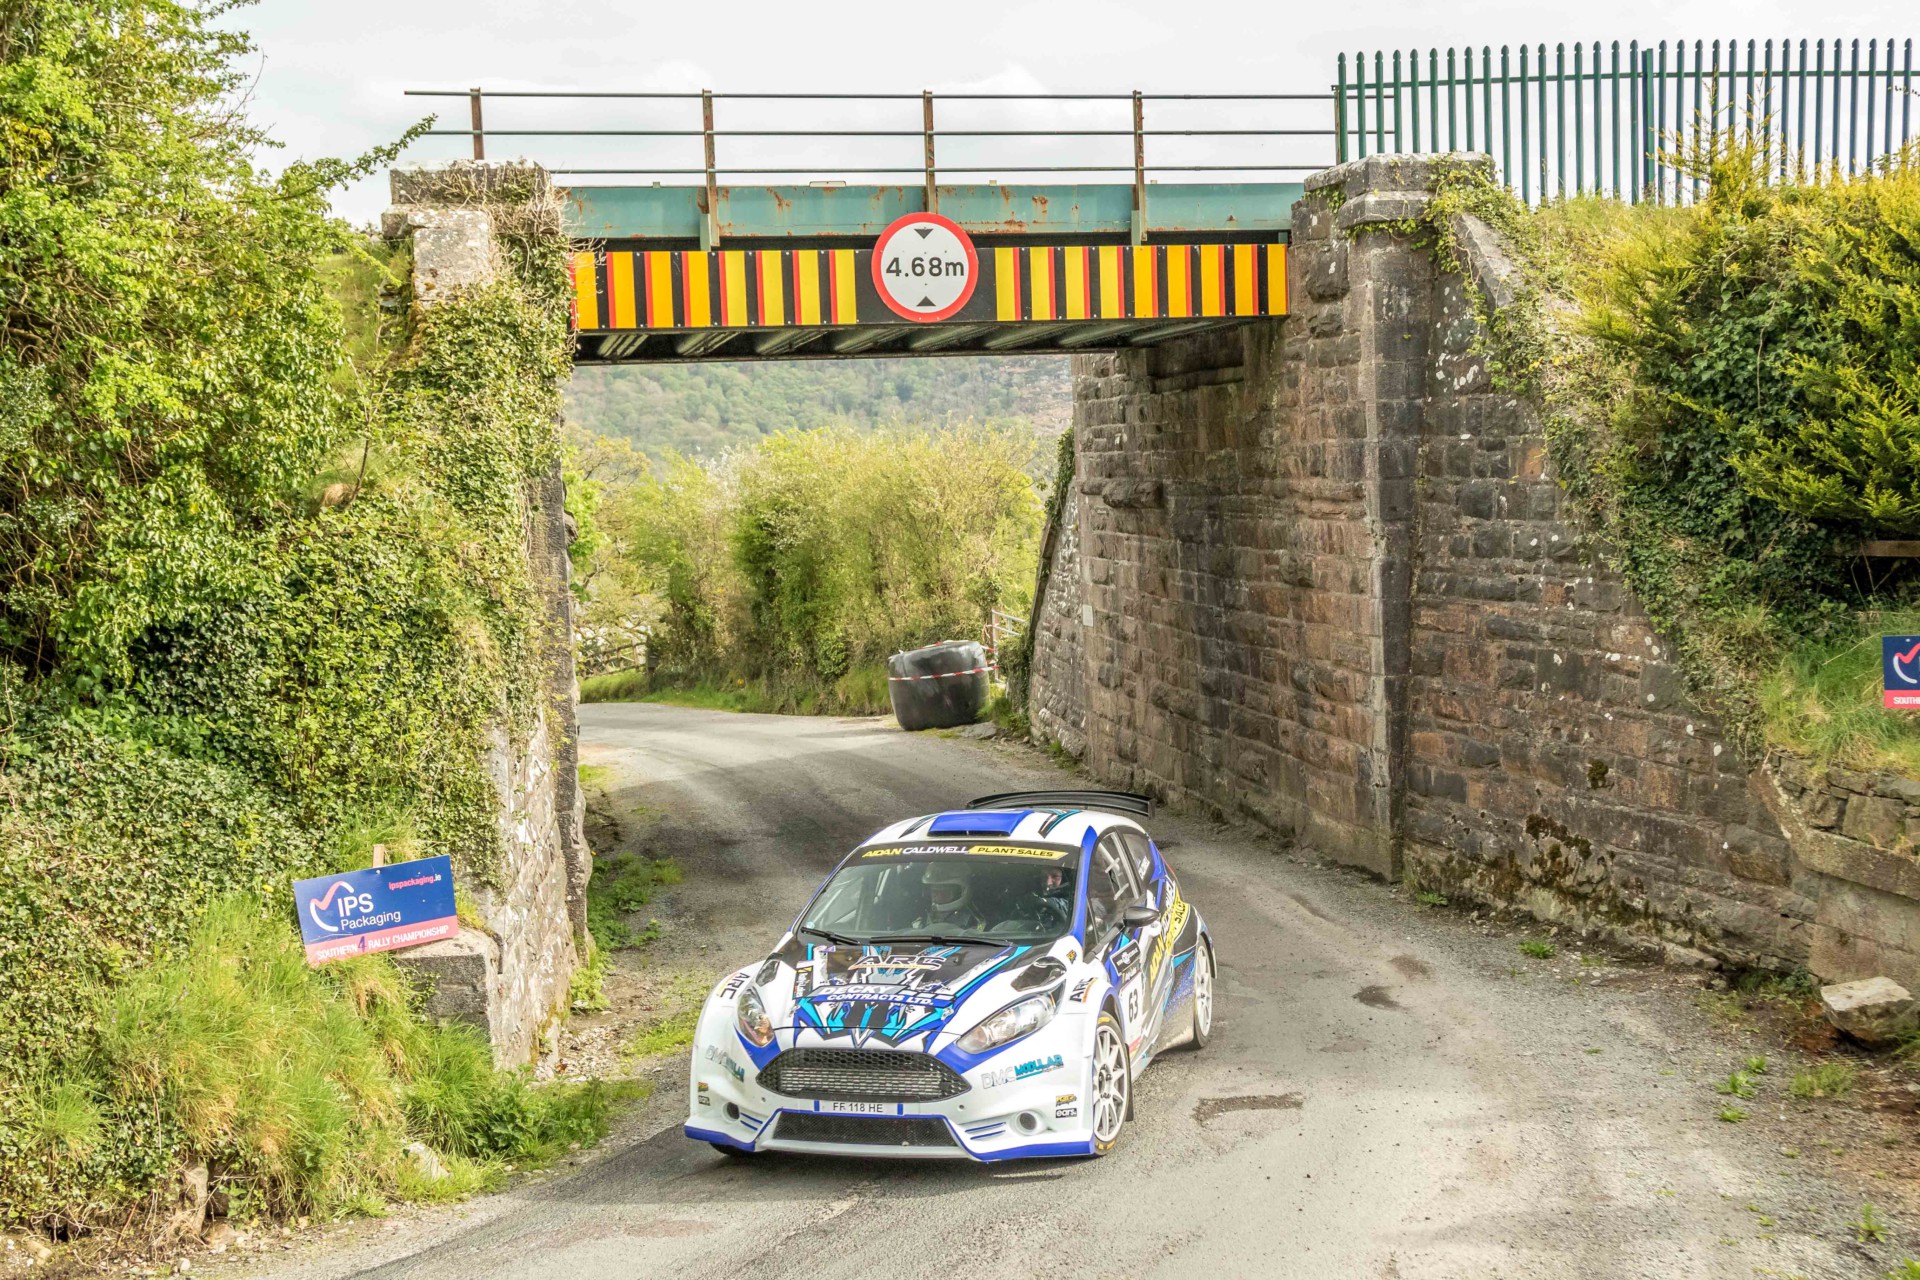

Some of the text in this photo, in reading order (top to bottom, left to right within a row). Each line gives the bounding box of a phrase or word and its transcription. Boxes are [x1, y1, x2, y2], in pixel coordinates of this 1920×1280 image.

[886, 257, 965, 277] 4.68m
[862, 846, 1054, 858] AIDAN CALDWELL PLANT SALES
[337, 893, 375, 918] IPS
[341, 911, 402, 931] Packaging
[316, 925, 449, 960] SOUTHERN 4 RALLY CHAMPIONSHIP
[719, 972, 751, 1000] ARC
[822, 984, 894, 995] DECKY
[826, 993, 934, 1006] CONTRACTS LTD.
[1128, 988, 1139, 1024] 63
[981, 1054, 1064, 1090] DMC MODULAR
[849, 1103, 866, 1112] 118
[869, 1104, 884, 1113] HE
